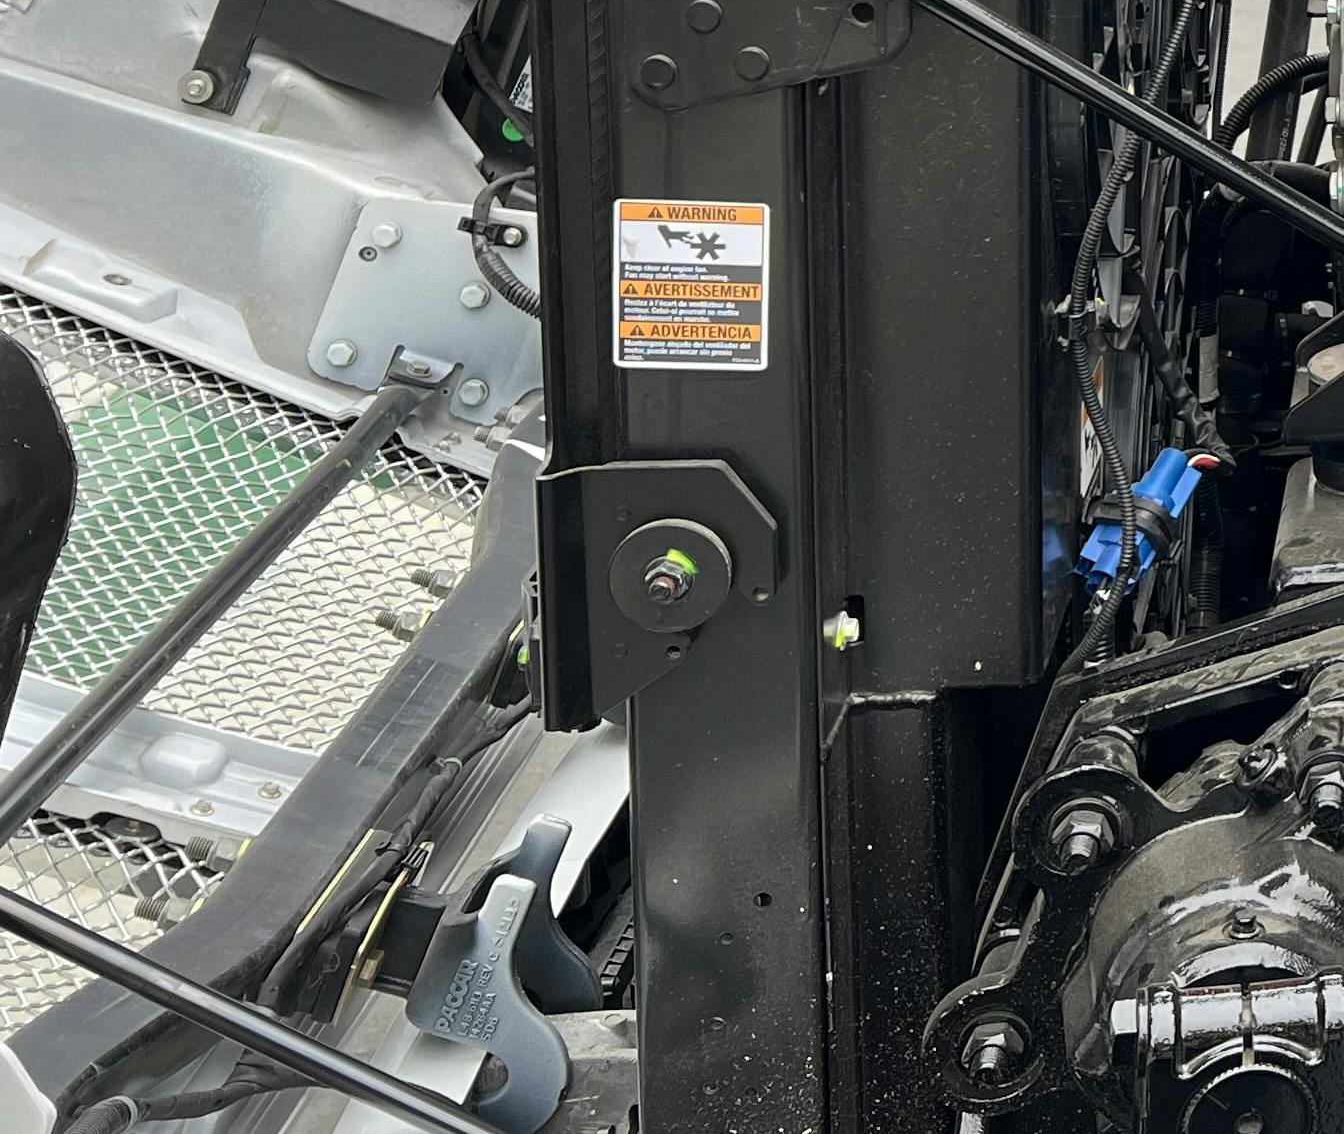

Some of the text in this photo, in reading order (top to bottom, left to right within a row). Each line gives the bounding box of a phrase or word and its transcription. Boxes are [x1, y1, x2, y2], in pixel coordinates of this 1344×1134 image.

[668, 207, 737, 221] WARNING
[644, 284, 759, 298] AVERTISSEMENT
[650, 325, 752, 339] ADVERTENCIA
[478, 964, 493, 988] REV
[435, 959, 479, 1033] PACCAR
